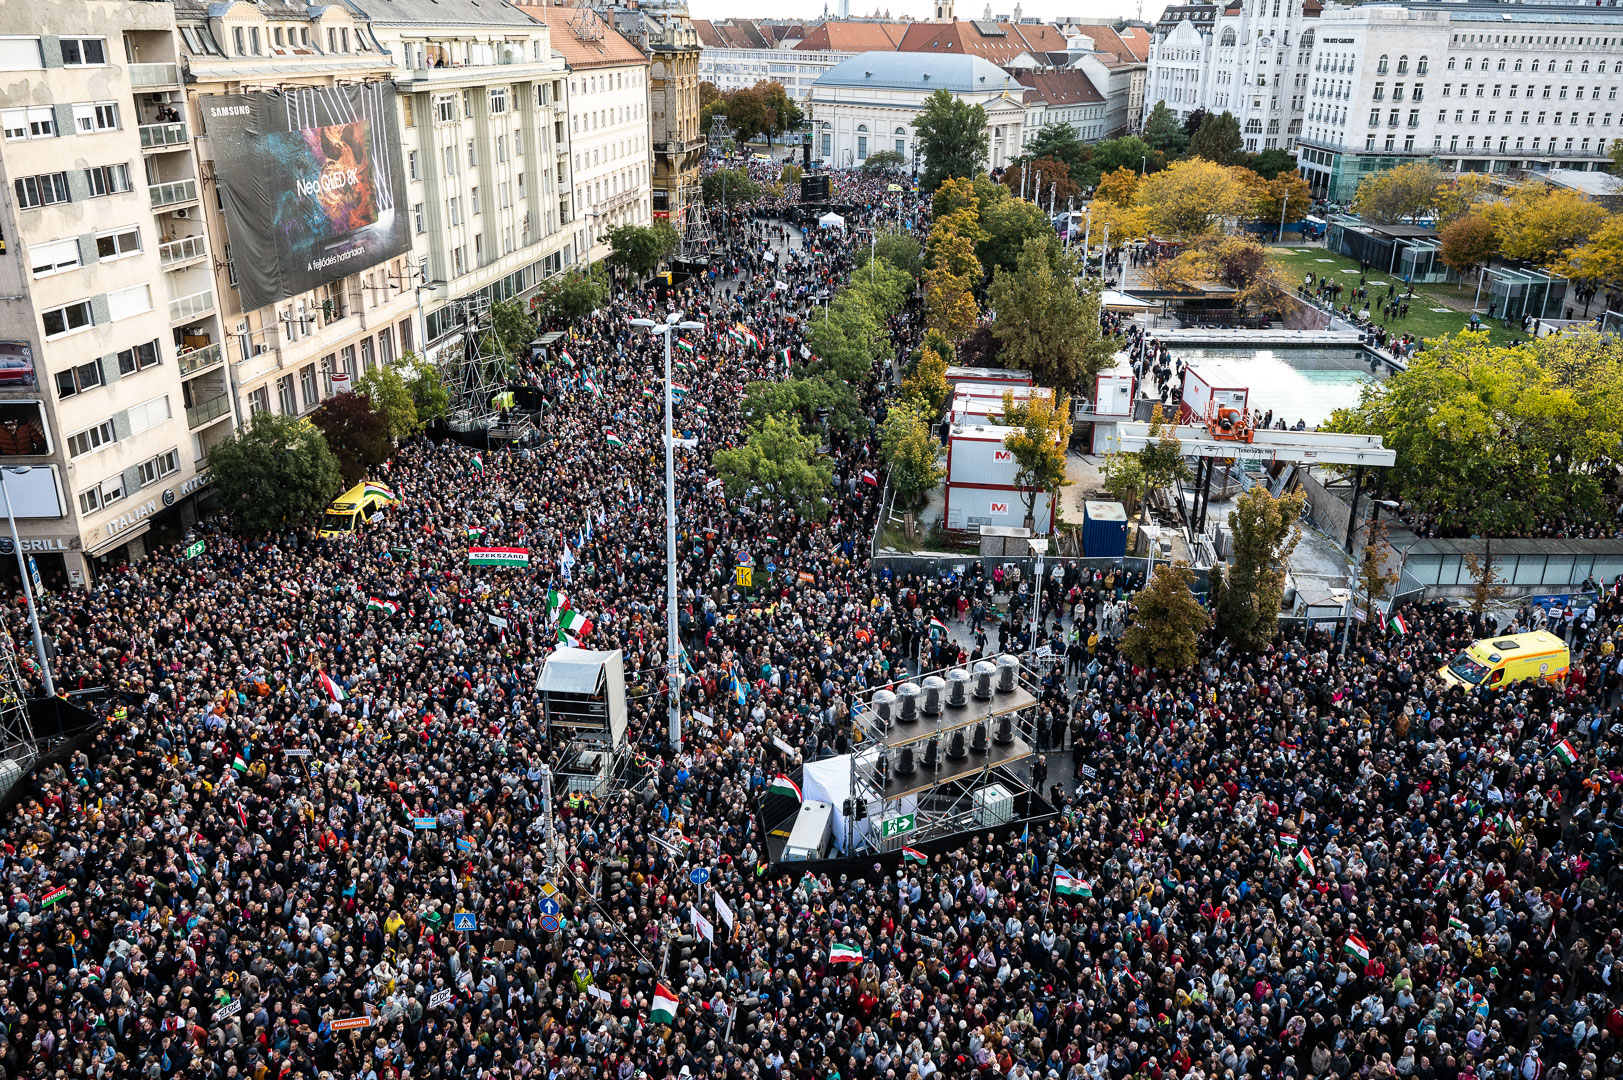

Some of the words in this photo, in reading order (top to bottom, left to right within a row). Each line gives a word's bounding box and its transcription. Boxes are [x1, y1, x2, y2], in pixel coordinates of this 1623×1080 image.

[211, 105, 250, 117] SAMSUNG
[296, 179, 320, 197] Neo
[320, 173, 346, 191] QLED
[347, 168, 360, 186] 8K
[307, 263, 313, 272] A
[313, 255, 337, 270] fejlődés
[337, 246, 366, 262] határtalan.
[106, 500, 156, 535] ITALIAN
[20, 538, 68, 551] GRILL
[431, 989, 450, 1002] STOP
[219, 1001, 240, 1016] STOP
[334, 1019, 367, 1028] RÁKOSMENTE
